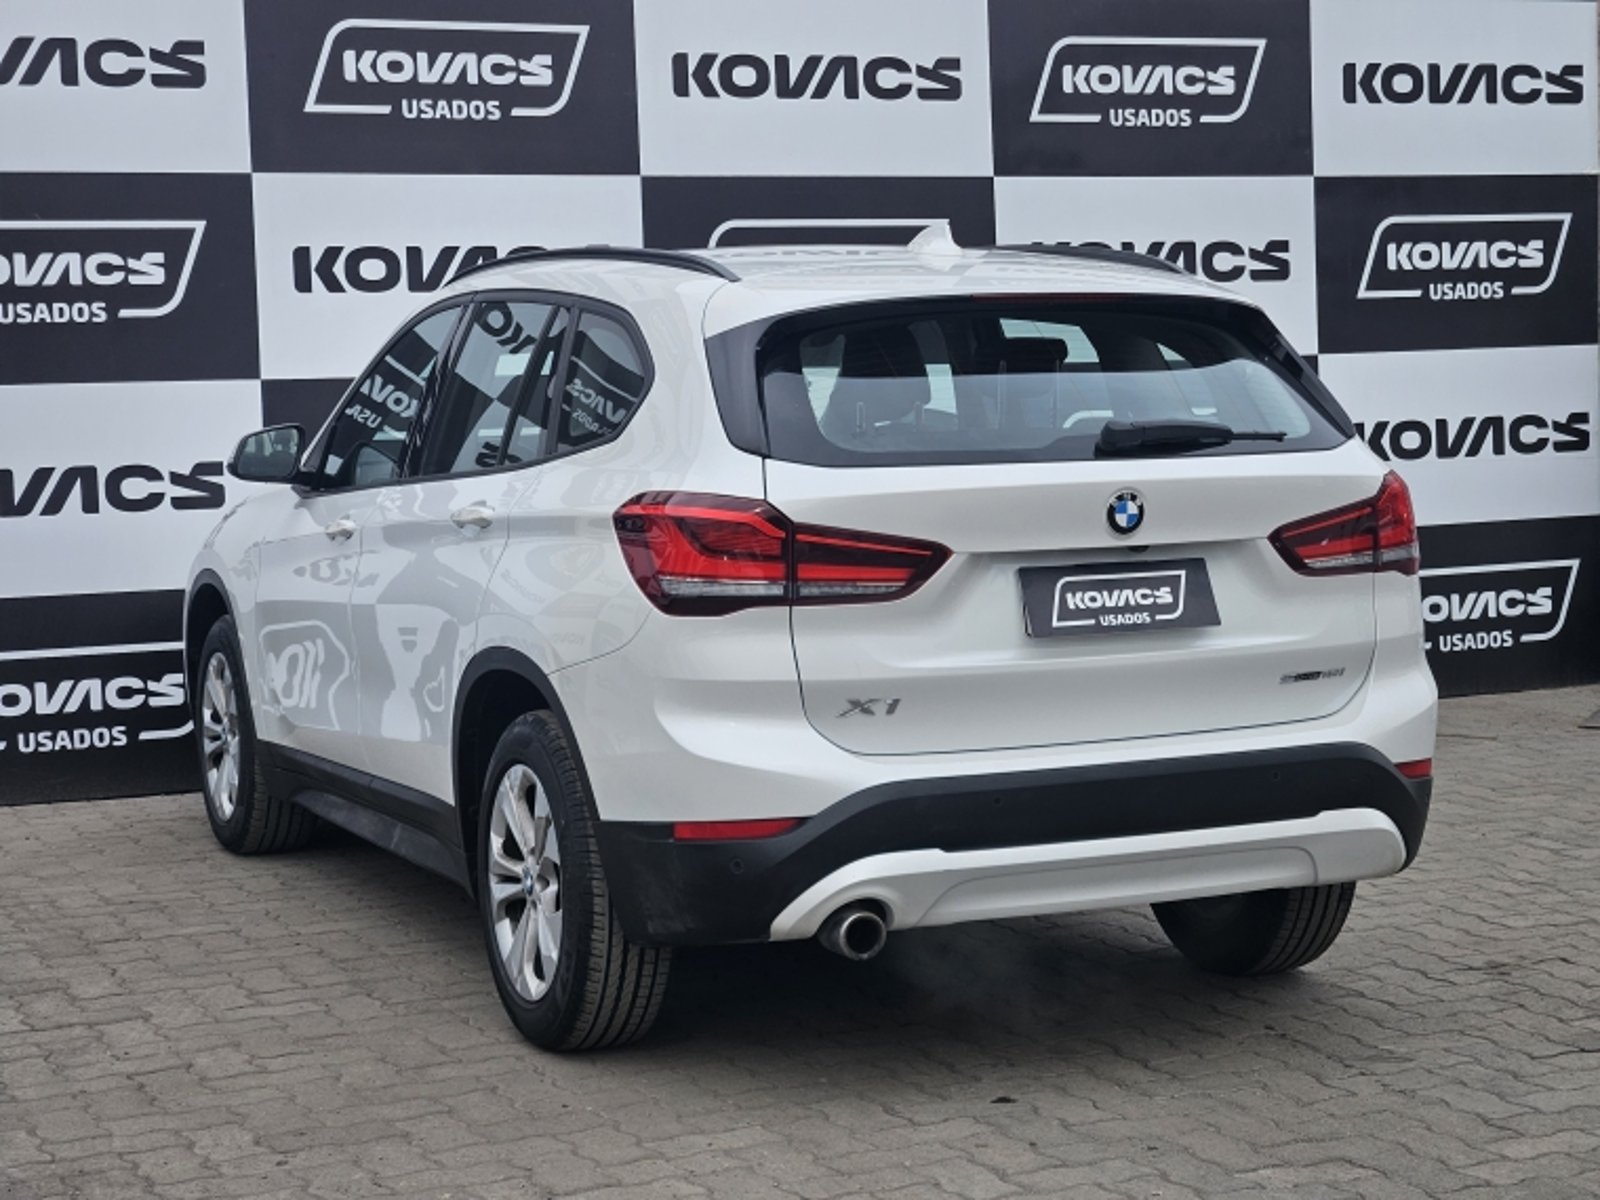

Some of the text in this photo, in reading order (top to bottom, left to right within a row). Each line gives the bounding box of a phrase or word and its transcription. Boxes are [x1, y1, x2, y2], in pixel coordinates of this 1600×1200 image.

[342, 49, 553, 86] KOVACS
[671, 52, 962, 101] KOVACS
[1062, 64, 1236, 95] KOVACS
[1343, 62, 1584, 104] KOVACS
[401, 98, 501, 120] USADOS
[1109, 108, 1192, 127] USADOS
[1386, 239, 1544, 271] KOVACS
[1429, 281, 1504, 300] USADOS
[0, 302, 108, 324] USADOS
[1066, 586, 1173, 610] KOVACS
[1099, 612, 1151, 626] USADOS
[1439, 629, 1513, 652] USADOS
[835, 698, 902, 718] X1
[17, 725, 128, 753] USADOS
